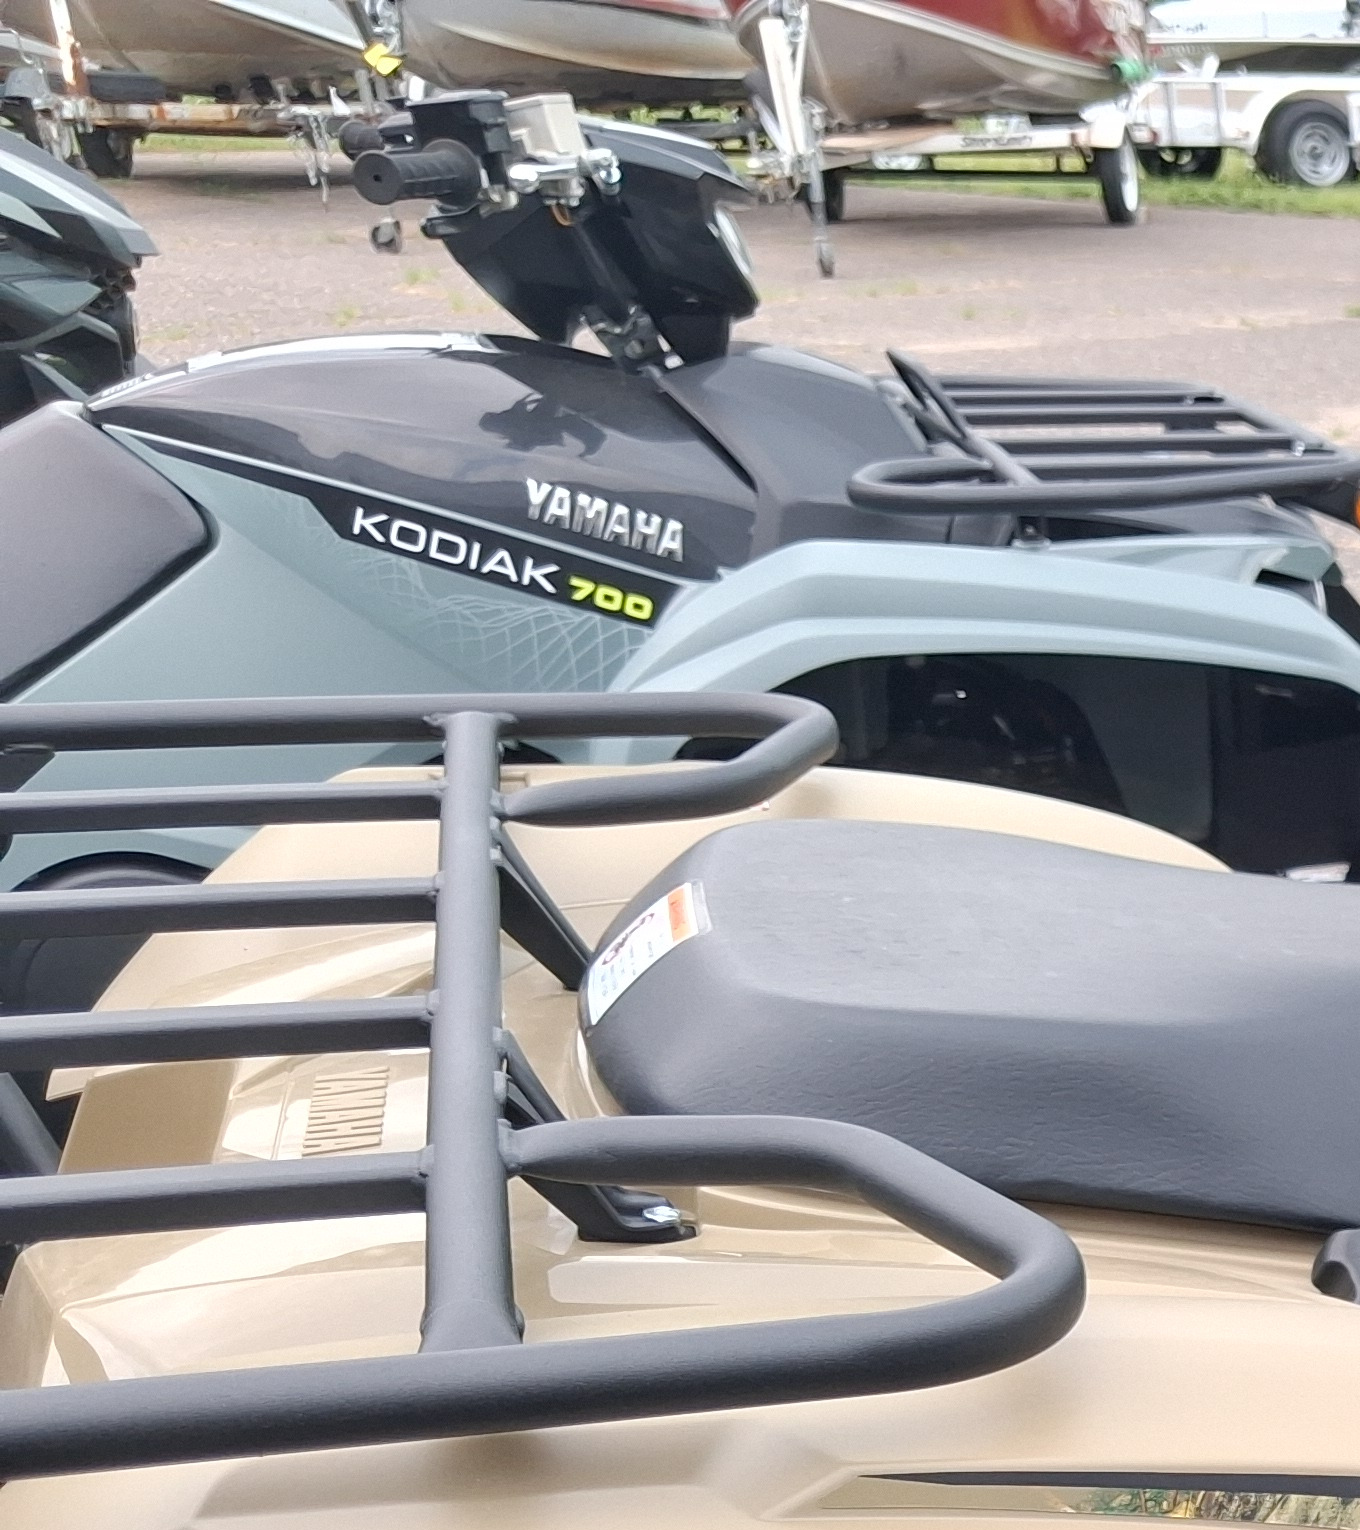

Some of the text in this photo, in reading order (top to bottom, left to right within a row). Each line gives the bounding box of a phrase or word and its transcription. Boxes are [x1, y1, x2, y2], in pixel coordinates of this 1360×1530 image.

[351, 506, 655, 623] KODIAK 700
[525, 478, 685, 564] YAMAHA
[301, 1066, 390, 1158] YAMAHA
